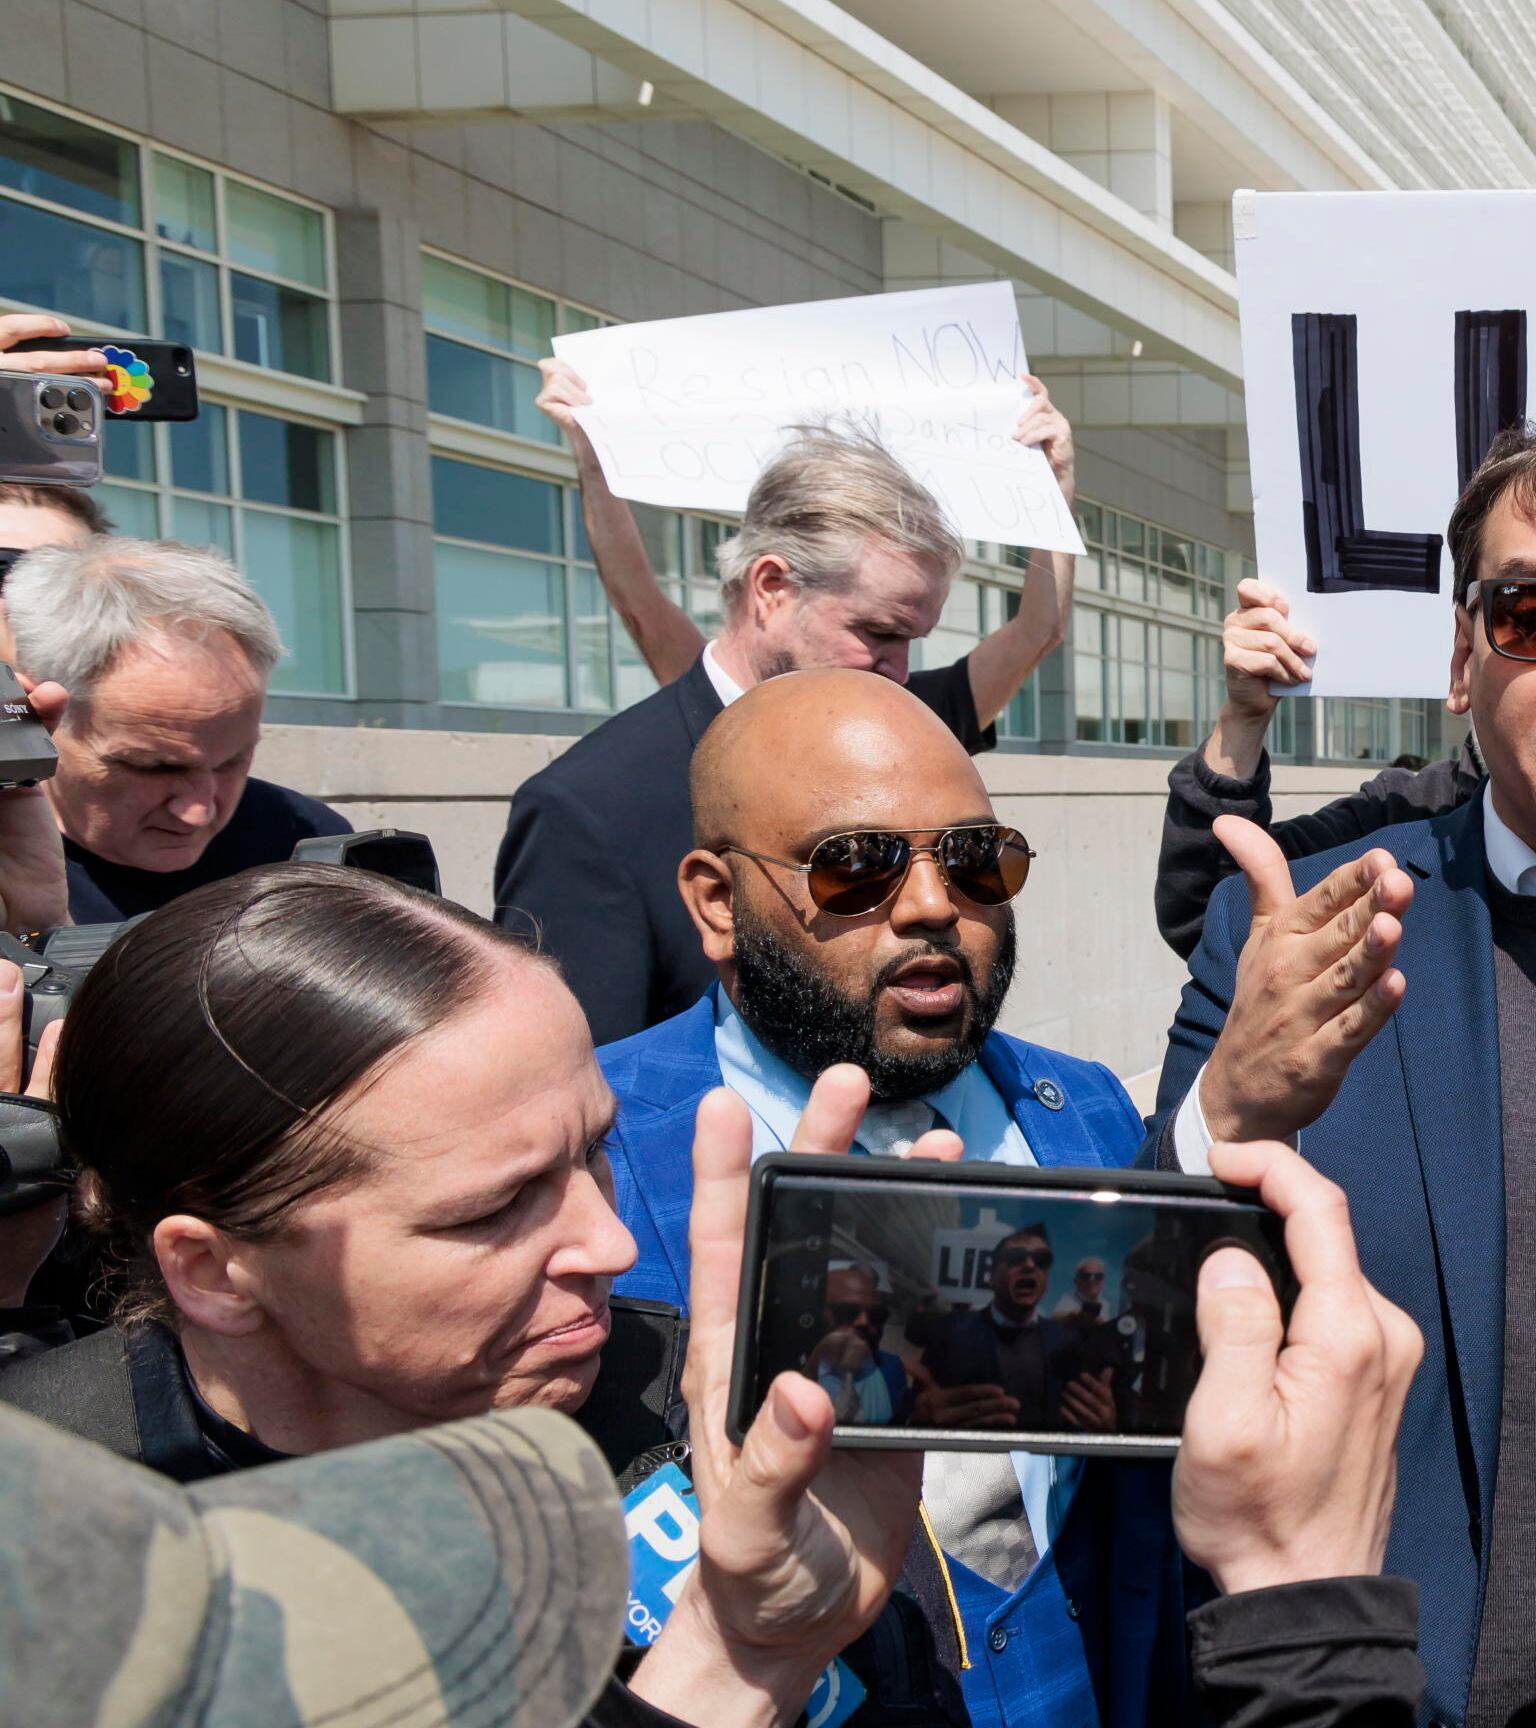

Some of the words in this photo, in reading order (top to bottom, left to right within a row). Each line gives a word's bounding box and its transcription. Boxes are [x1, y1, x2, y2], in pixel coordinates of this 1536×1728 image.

[890, 320, 1019, 391] NOW
[4, 703, 28, 714] SONY
[628, 1590, 662, 1643] YOR
